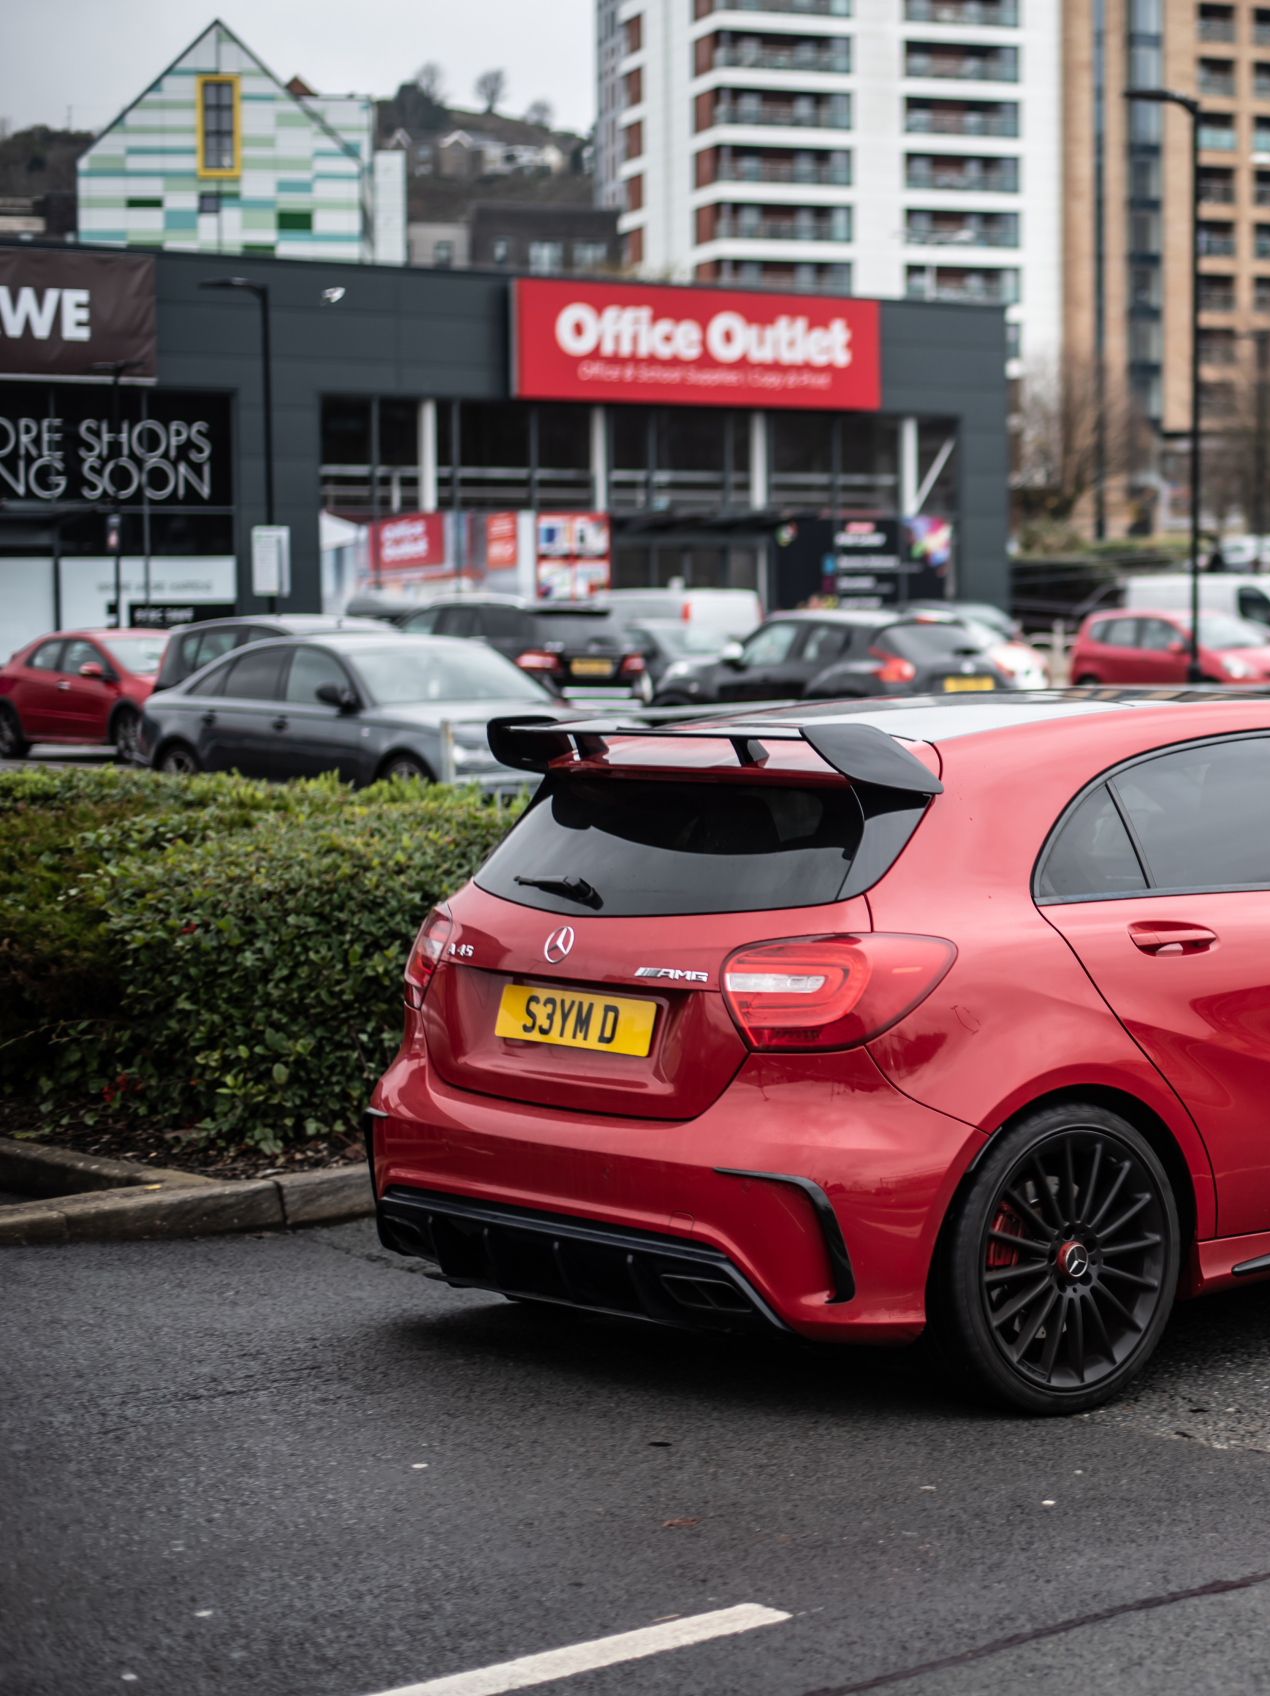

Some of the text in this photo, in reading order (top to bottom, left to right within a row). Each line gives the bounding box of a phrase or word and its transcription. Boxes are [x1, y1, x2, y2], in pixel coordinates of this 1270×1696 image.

[555, 301, 853, 369] Office Outlet
[78, 418, 212, 463] SHOPS
[81, 457, 211, 500] SOON
[657, 968, 709, 983] AMG
[522, 995, 620, 1045] S3YM D
